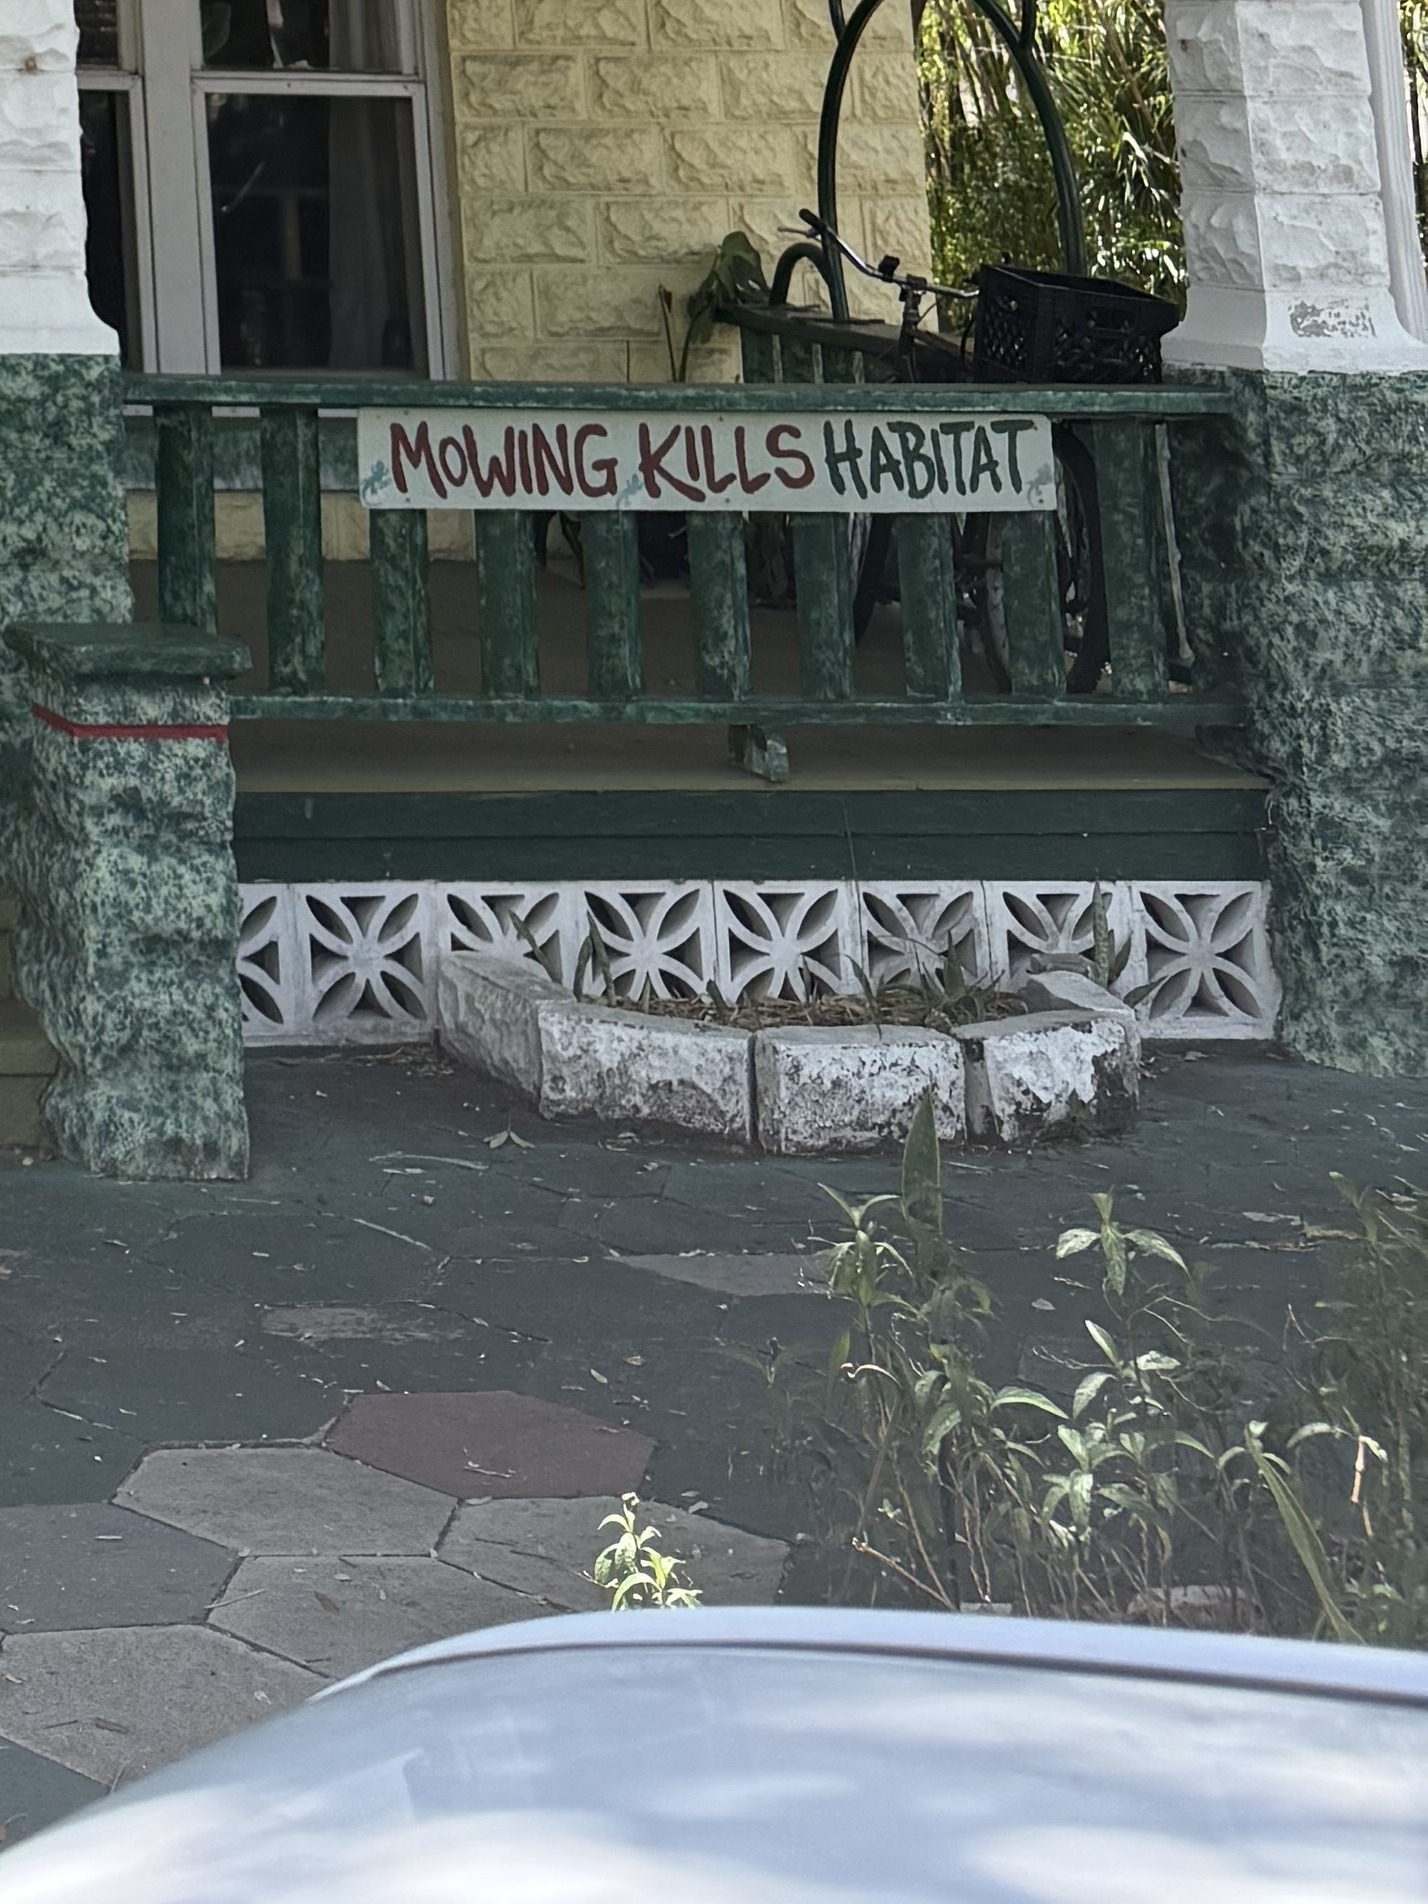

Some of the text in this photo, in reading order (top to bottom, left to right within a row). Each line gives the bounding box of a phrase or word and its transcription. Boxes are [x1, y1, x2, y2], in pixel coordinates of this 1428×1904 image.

[390, 419, 1036, 503] MOWING KILLS HABITAT
